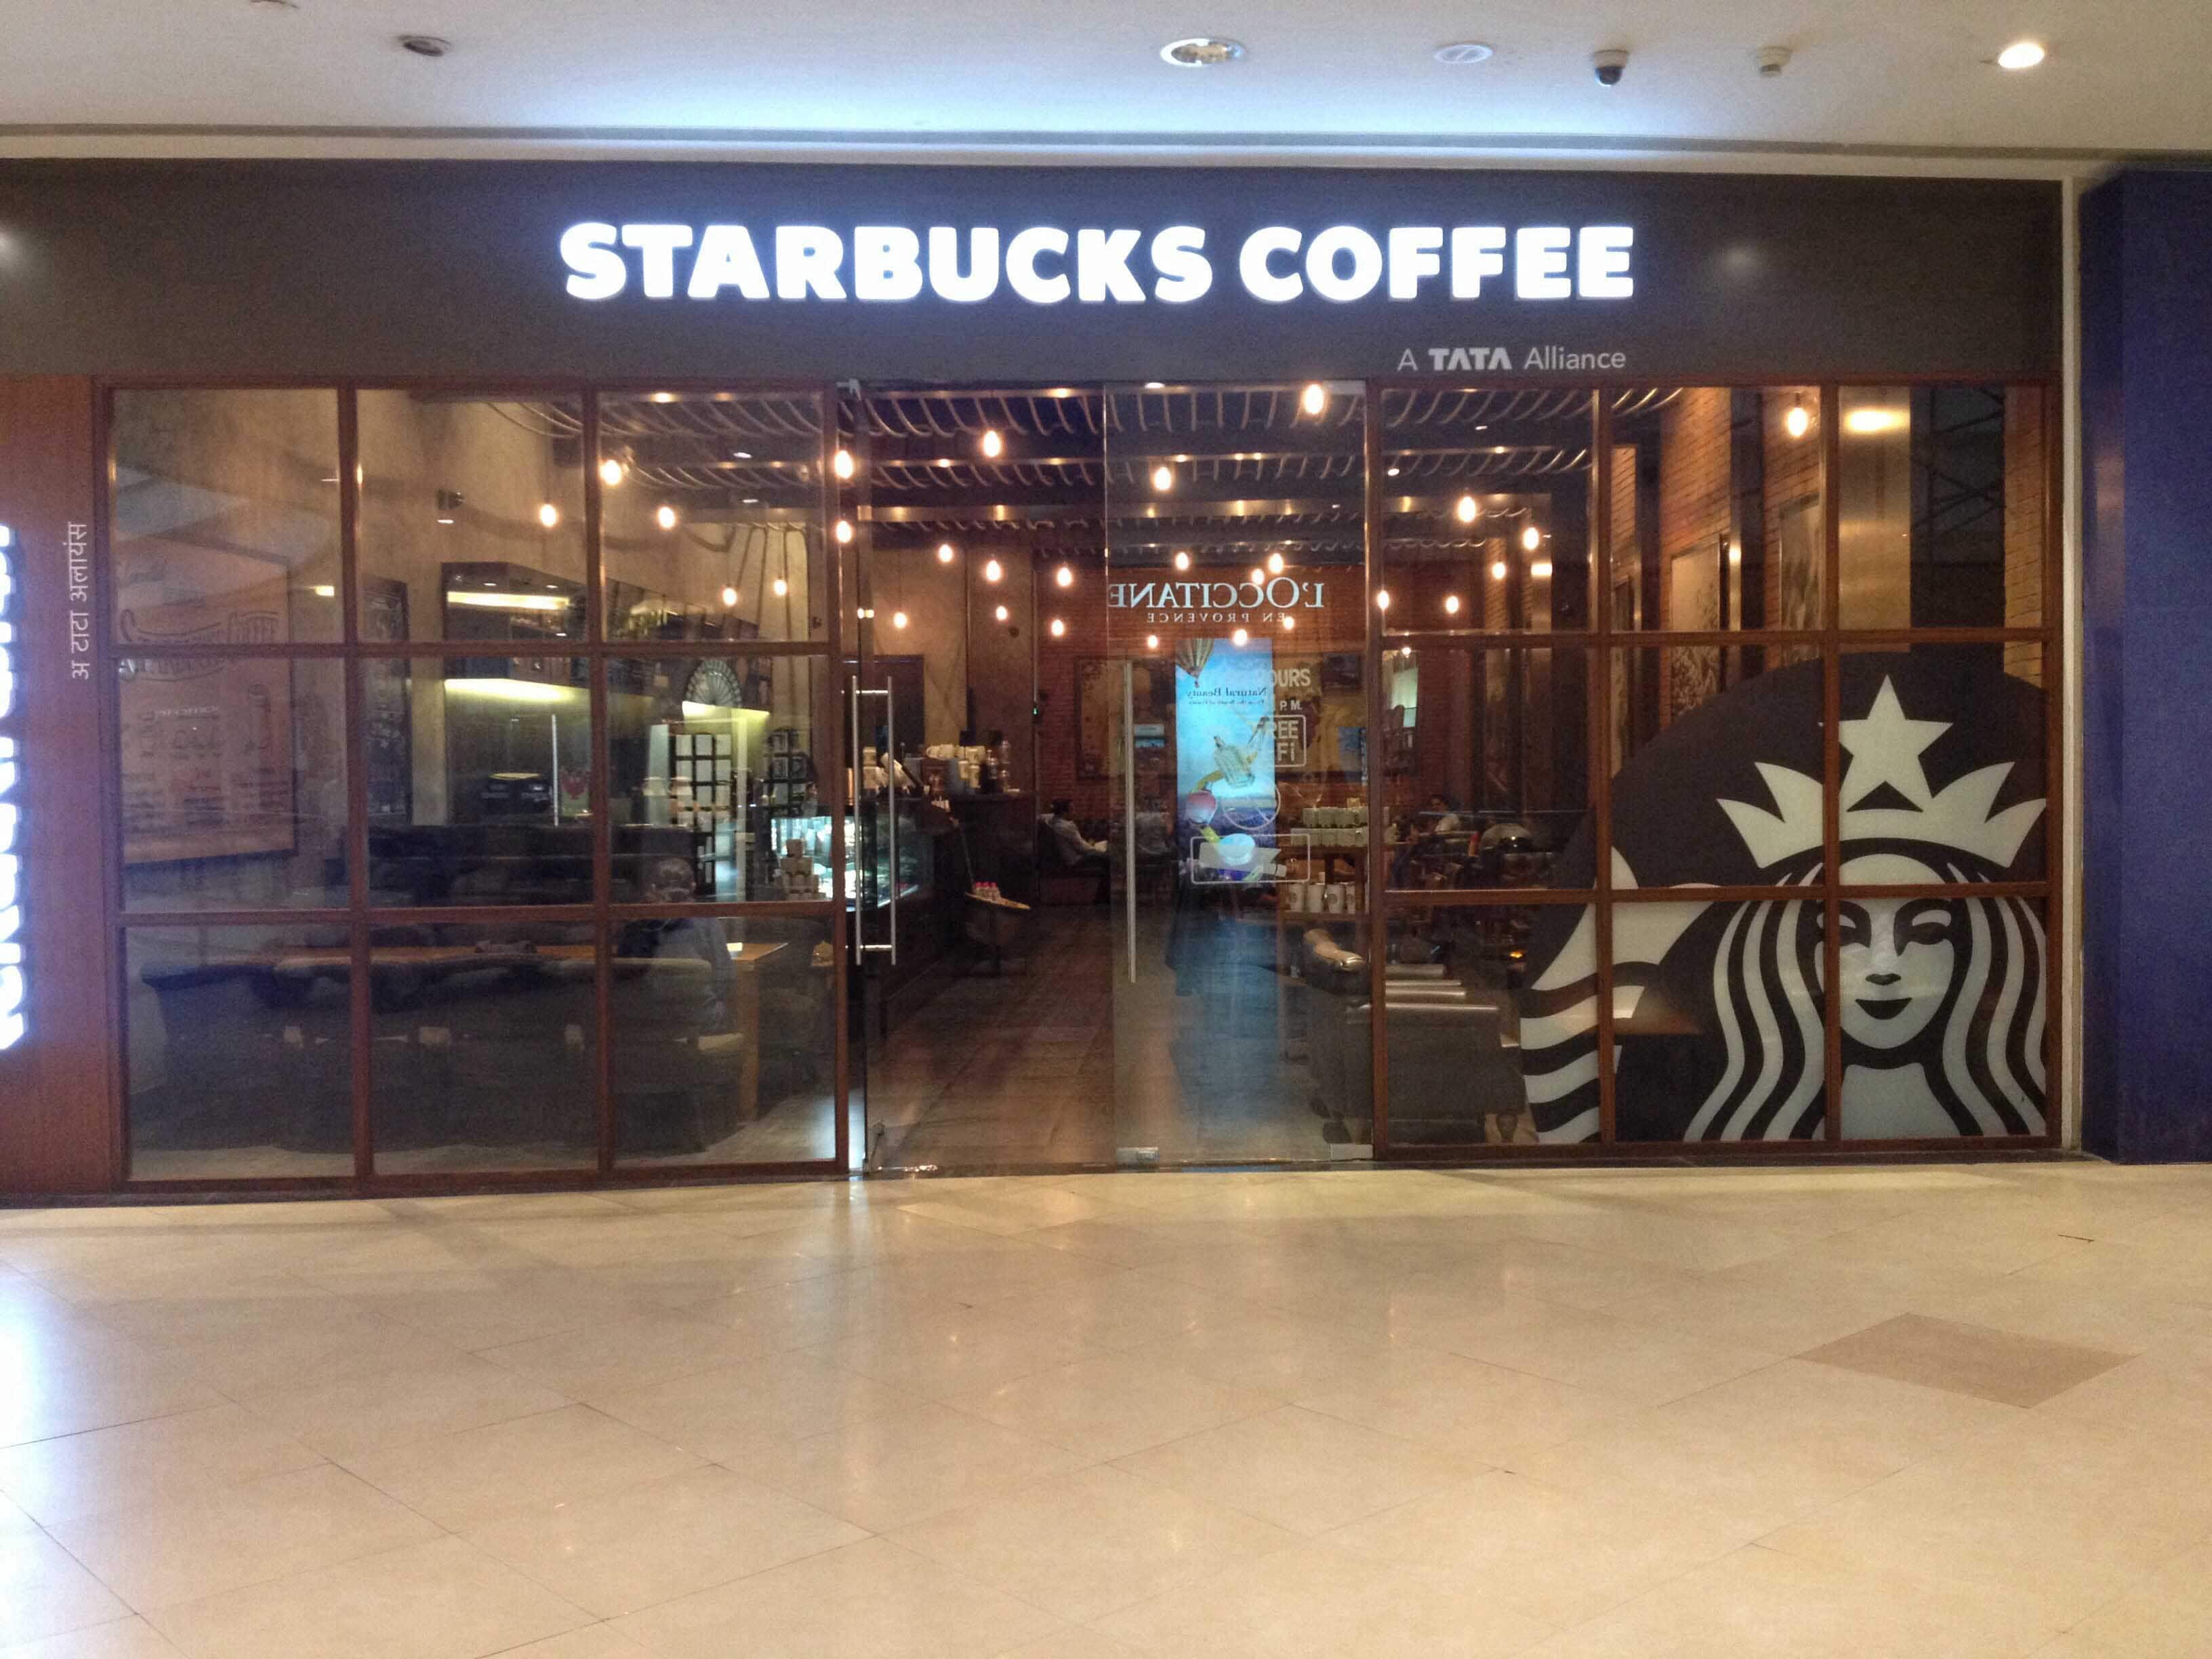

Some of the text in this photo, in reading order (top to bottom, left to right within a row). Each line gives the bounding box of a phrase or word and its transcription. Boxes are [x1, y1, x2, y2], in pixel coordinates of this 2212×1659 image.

[560, 222, 1635, 304] STARBUCKS COFFEE
[1397, 346, 1626, 371] A TATA Alliance
[62, 521, 90, 680] अ टाटा अलायंस
[1262, 668, 1312, 687] OURS
